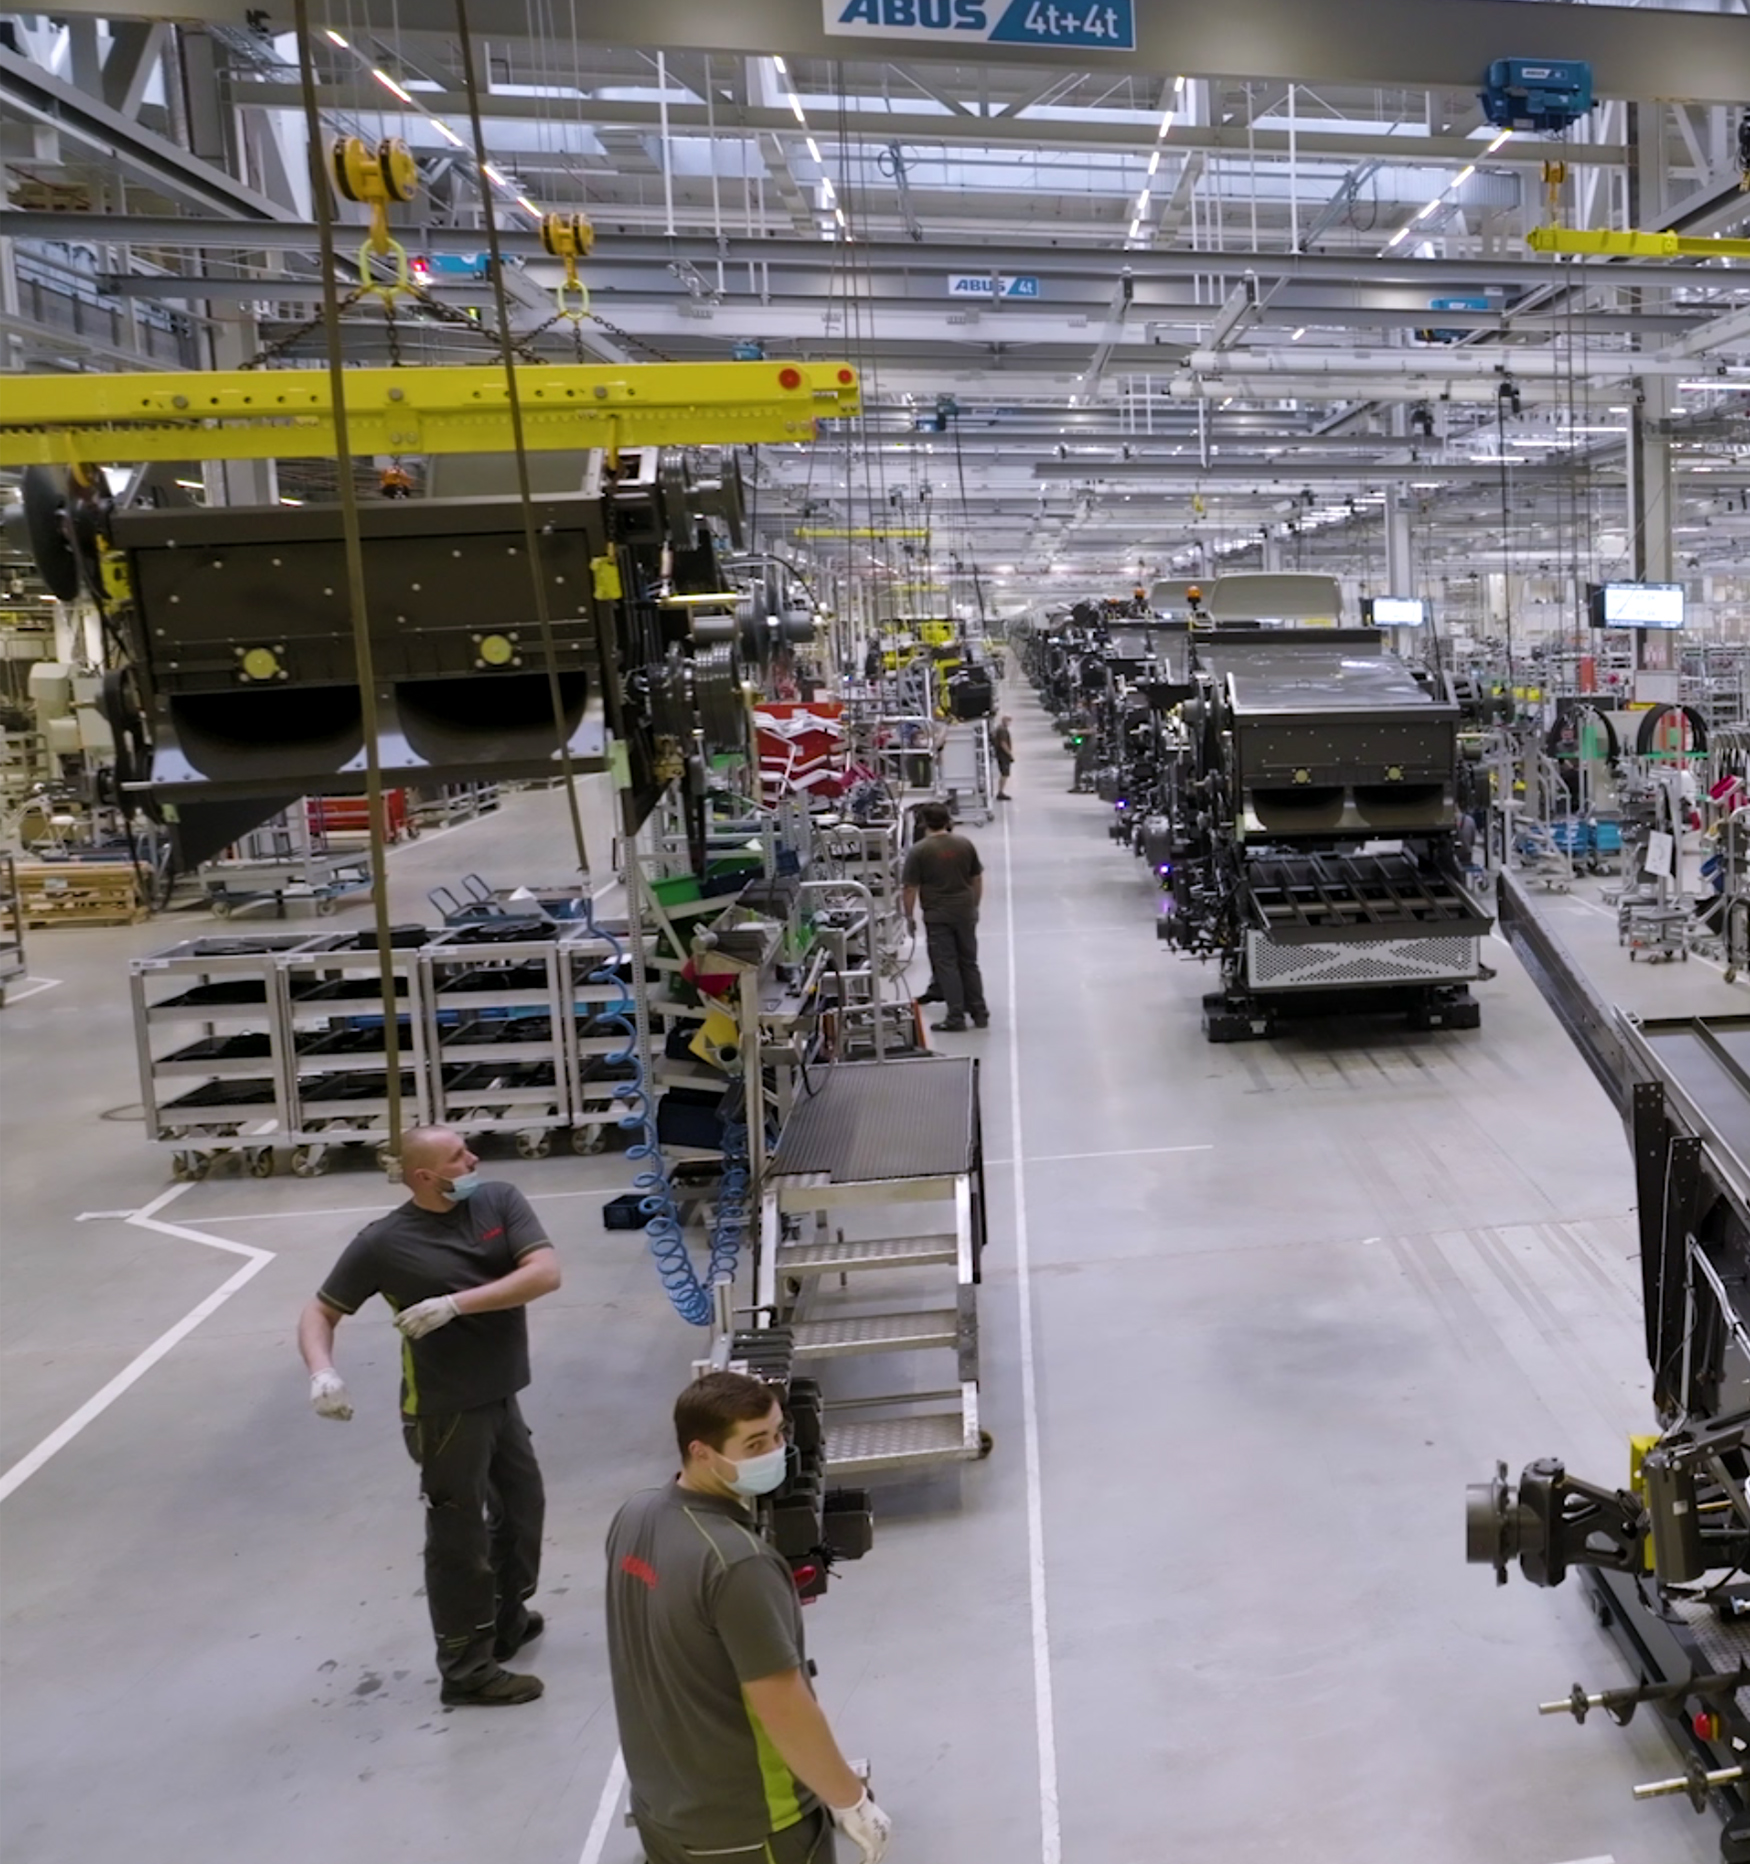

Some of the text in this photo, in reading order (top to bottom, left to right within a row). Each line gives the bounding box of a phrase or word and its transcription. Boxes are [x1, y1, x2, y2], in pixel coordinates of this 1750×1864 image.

[838, 0, 1119, 38] ABUS 4t+4t
[955, 279, 1034, 294] ABUS 4t
